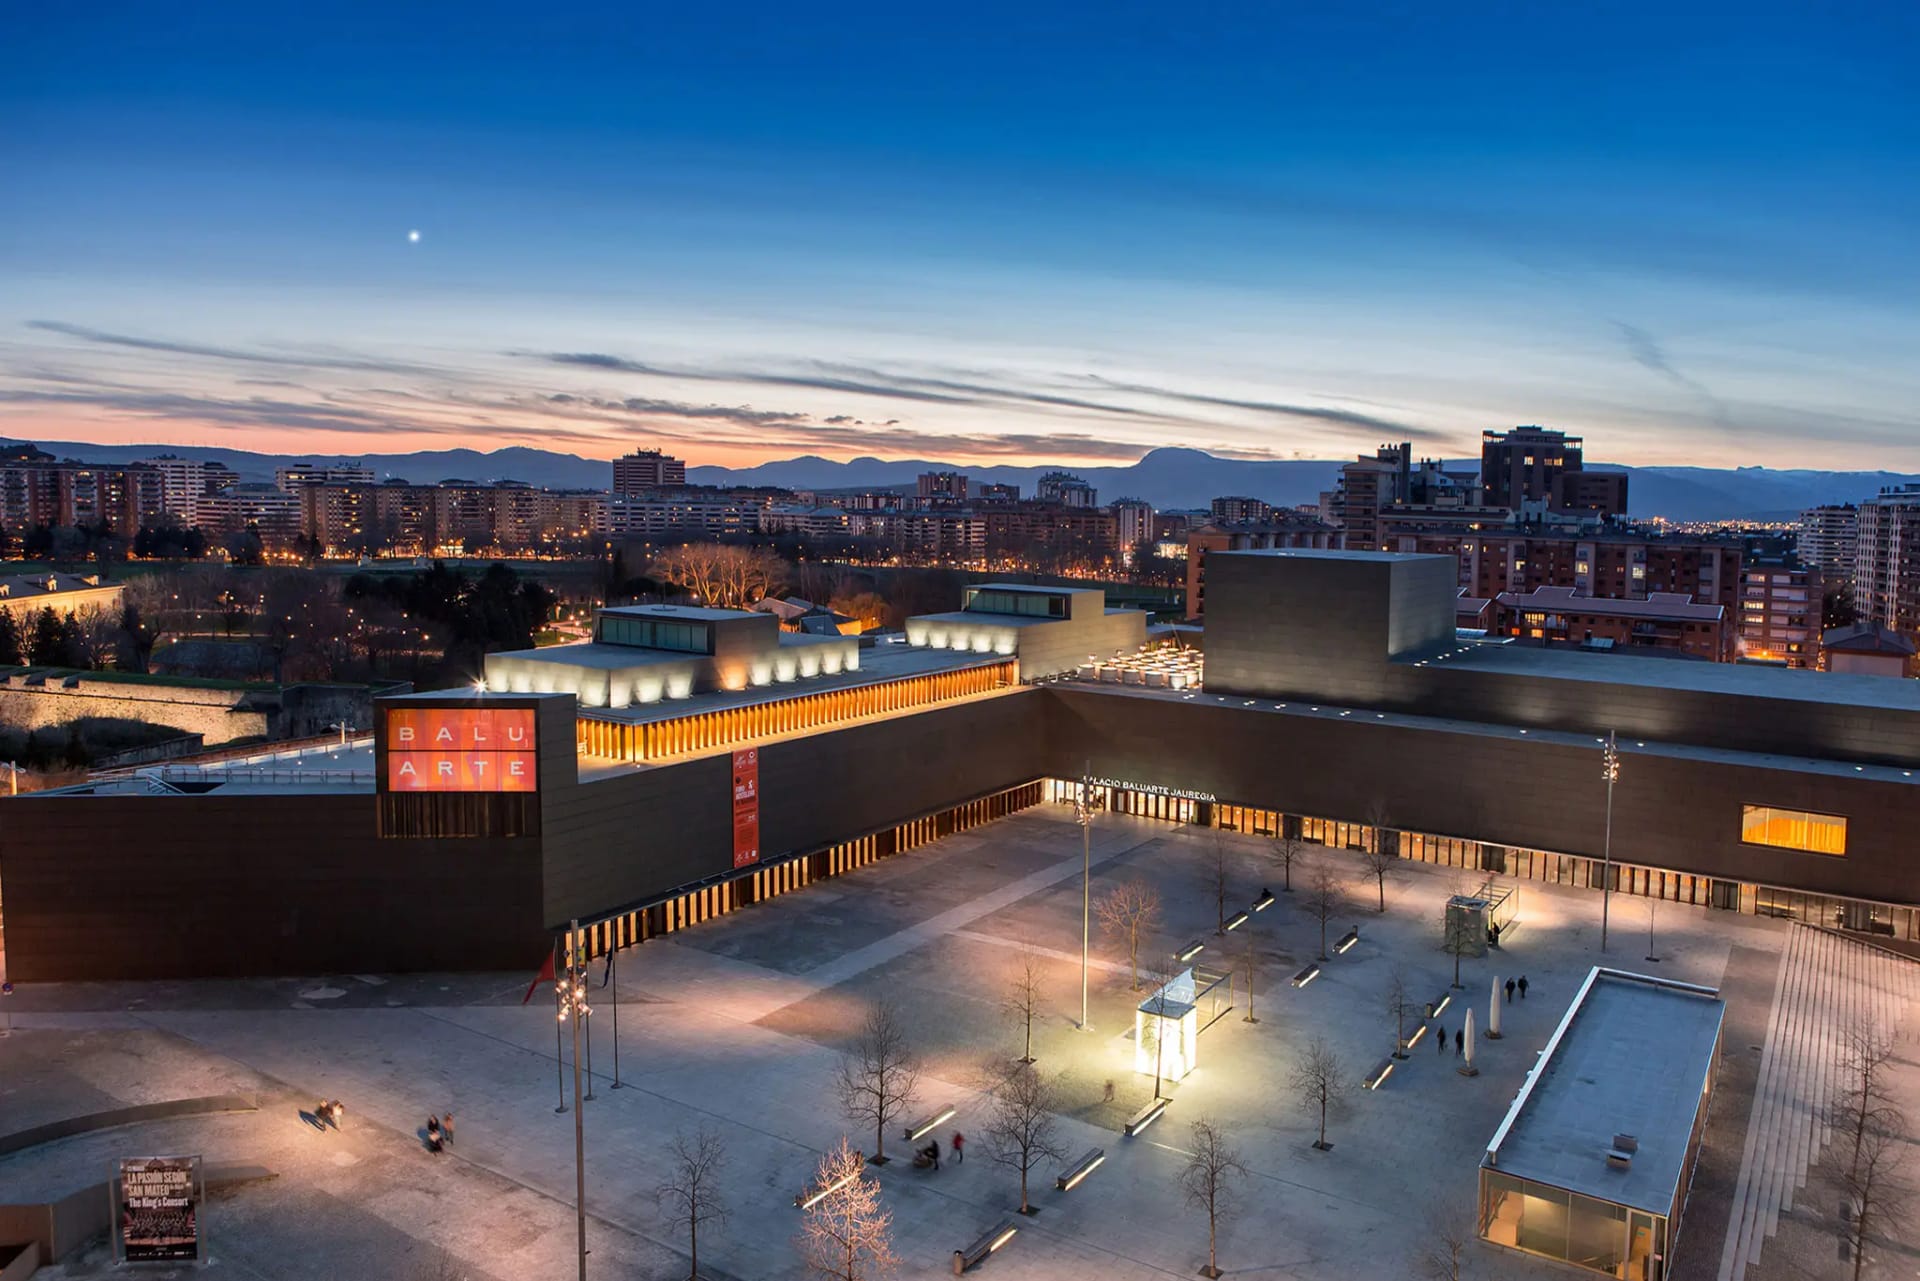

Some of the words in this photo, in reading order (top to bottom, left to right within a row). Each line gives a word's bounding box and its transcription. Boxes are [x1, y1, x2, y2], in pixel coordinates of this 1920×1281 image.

[399, 726, 524, 742] BALU
[399, 761, 525, 776] ARTE
[1122, 781, 1169, 796] BALUARTE
[1170, 788, 1217, 802] JAUREGIA
[128, 1185, 143, 1197] SAN
[144, 1183, 170, 1196] MATEO
[129, 1197, 141, 1208] The
[142, 1196, 162, 1209] King's
[162, 1196, 188, 1207] Consort
